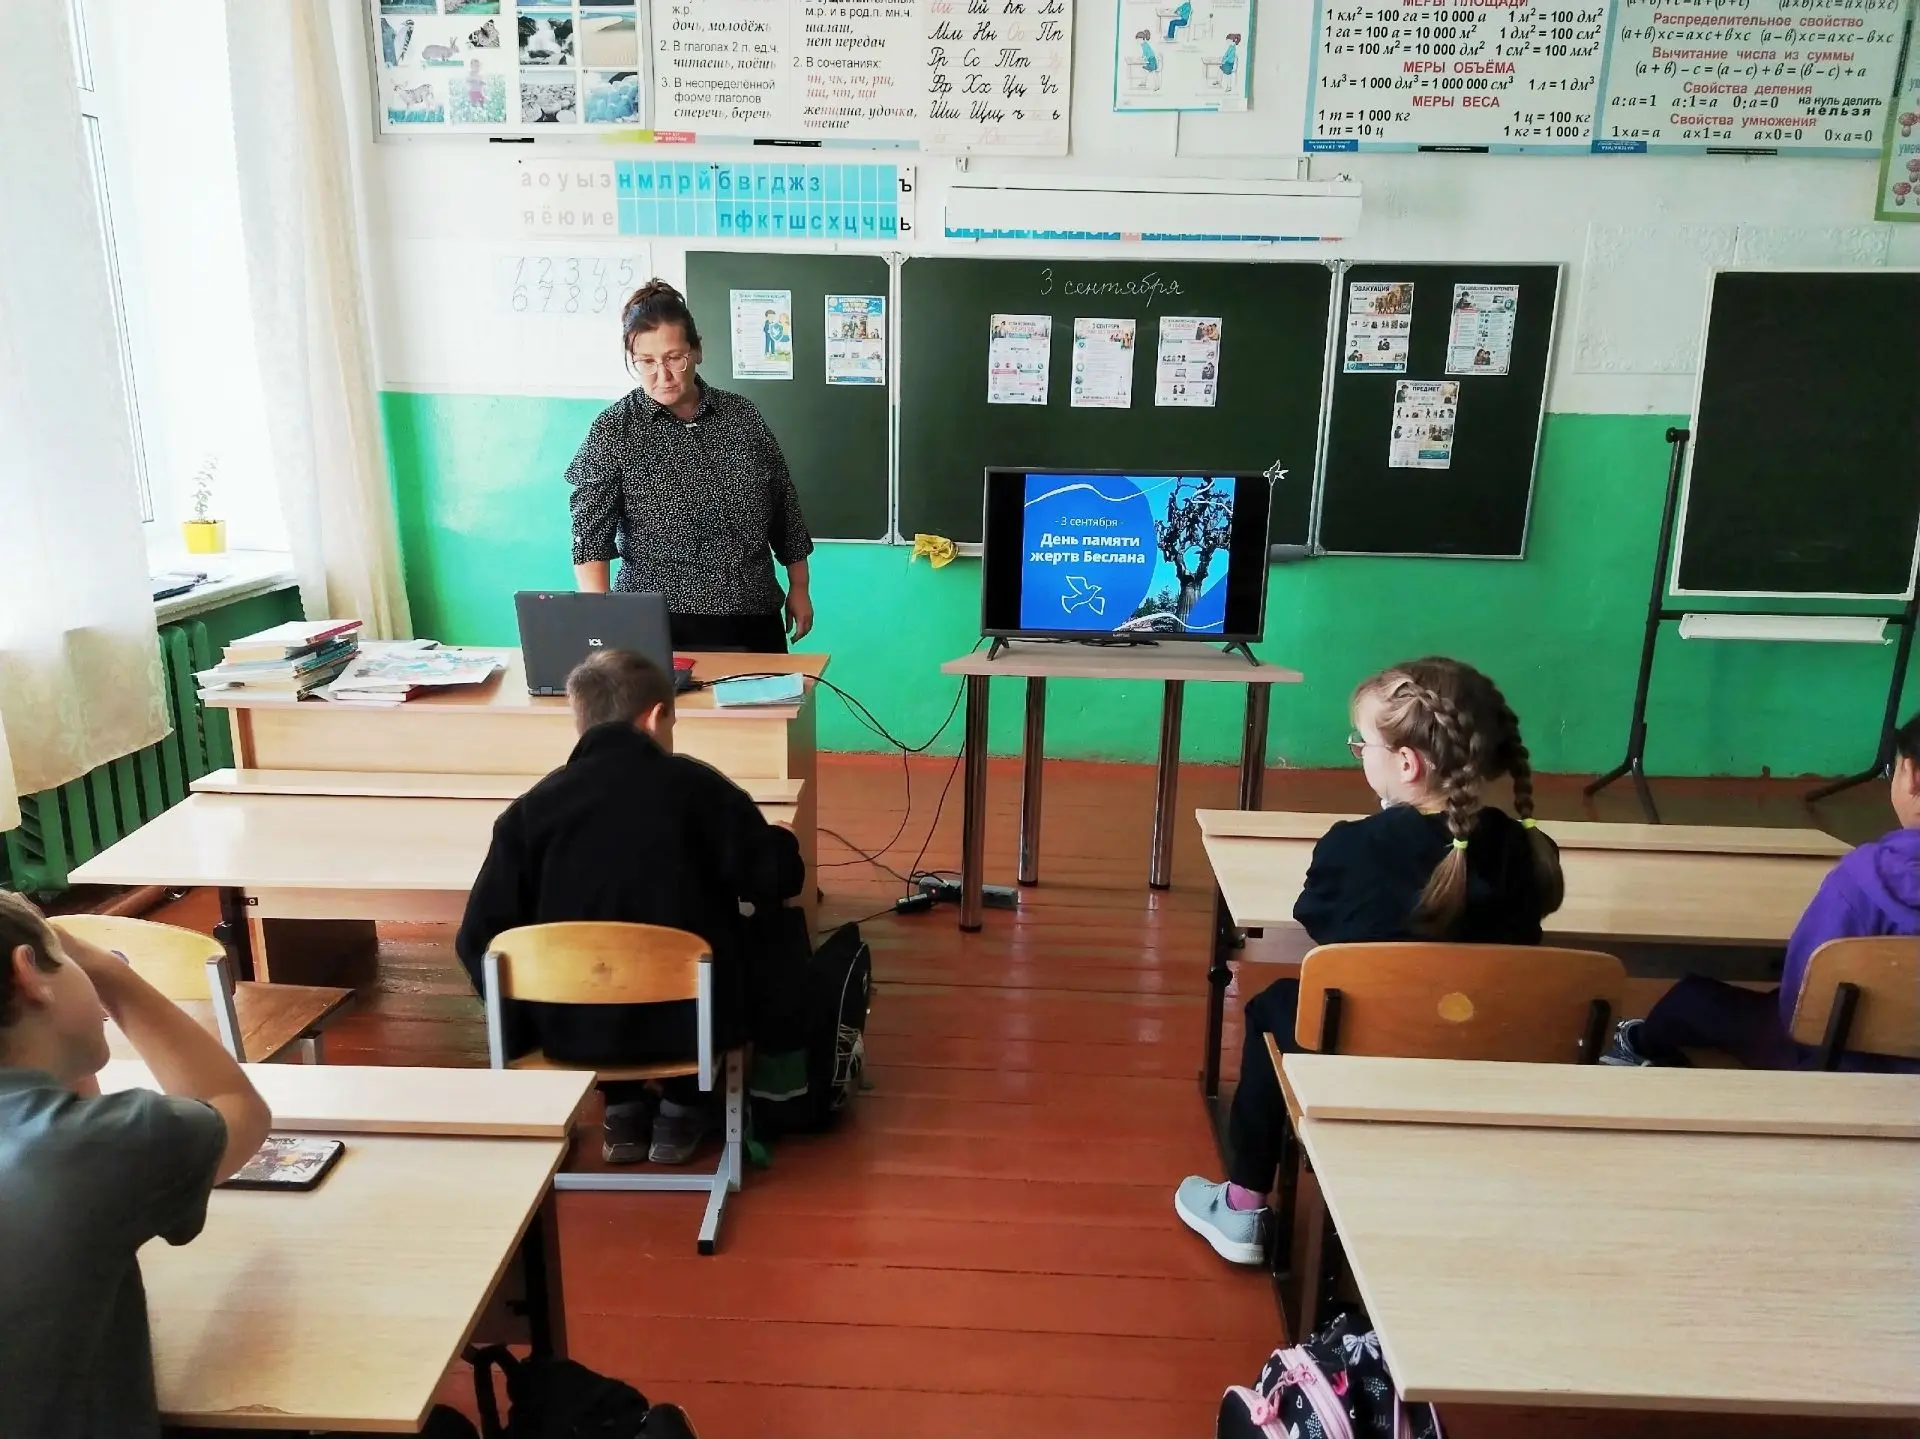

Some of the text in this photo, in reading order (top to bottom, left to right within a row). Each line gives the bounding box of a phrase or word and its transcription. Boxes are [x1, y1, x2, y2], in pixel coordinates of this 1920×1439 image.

[805, 7, 826, 18] м.р.
[830, 8, 836, 16] и
[840, 8, 846, 16] в
[1327, 9, 1332, 20] 1
[1378, 10, 1399, 21] 100
[1403, 12, 1417, 21] га
[1509, 11, 1514, 22] 1
[1551, 11, 1573, 23] 100
[709, 19, 771, 32] молодёжь
[1653, 12, 1864, 27] Распределительное свойство
[660, 40, 670, 52] 2.
[673, 40, 681, 52] В
[684, 42, 729, 52] глаголах
[732, 42, 739, 52] 2
[806, 35, 886, 51] нет передач
[1652, 46, 1855, 64] Вычитание числа из суммы
[793, 56, 881, 69] 2. В сочетаниях:
[1404, 59, 1515, 73] МЕРЫ ОБЪЁМА
[661, 76, 671, 88] 3.
[674, 77, 682, 88] В
[1322, 76, 1327, 87] 1
[1361, 77, 1366, 88] 1
[1433, 78, 1438, 88] 1
[1529, 79, 1534, 90] 1
[1538, 82, 1546, 90] л
[1560, 79, 1566, 90] 1
[1683, 81, 1813, 96] Свойства деления
[674, 92, 762, 104] форме глаголов
[1412, 95, 1500, 108] МЕРЫ ВЕСА
[1798, 96, 1882, 107] на нуль делить
[732, 106, 771, 122] беречь
[1319, 110, 1324, 121] 1
[1359, 110, 1364, 121] 1
[1395, 112, 1410, 121] кг
[1514, 111, 1519, 122] 1
[1525, 113, 1533, 125] ц
[1550, 112, 1571, 123] 100
[1575, 114, 1590, 123] кг
[1670, 113, 1817, 128] Свойства умножения
[803, 119, 850, 129] чтение
[619, 170, 912, 194] н м л р й б в г д ж з ъ
[720, 209, 911, 234] п ф к т ш с х ц ч щ ь
[1040, 268, 1185, 308] 3 сентября
[1060, 516, 1118, 529] 3 сентября
[1040, 533, 1140, 548] День памяти
[1029, 550, 1146, 566] жертв Беслана
